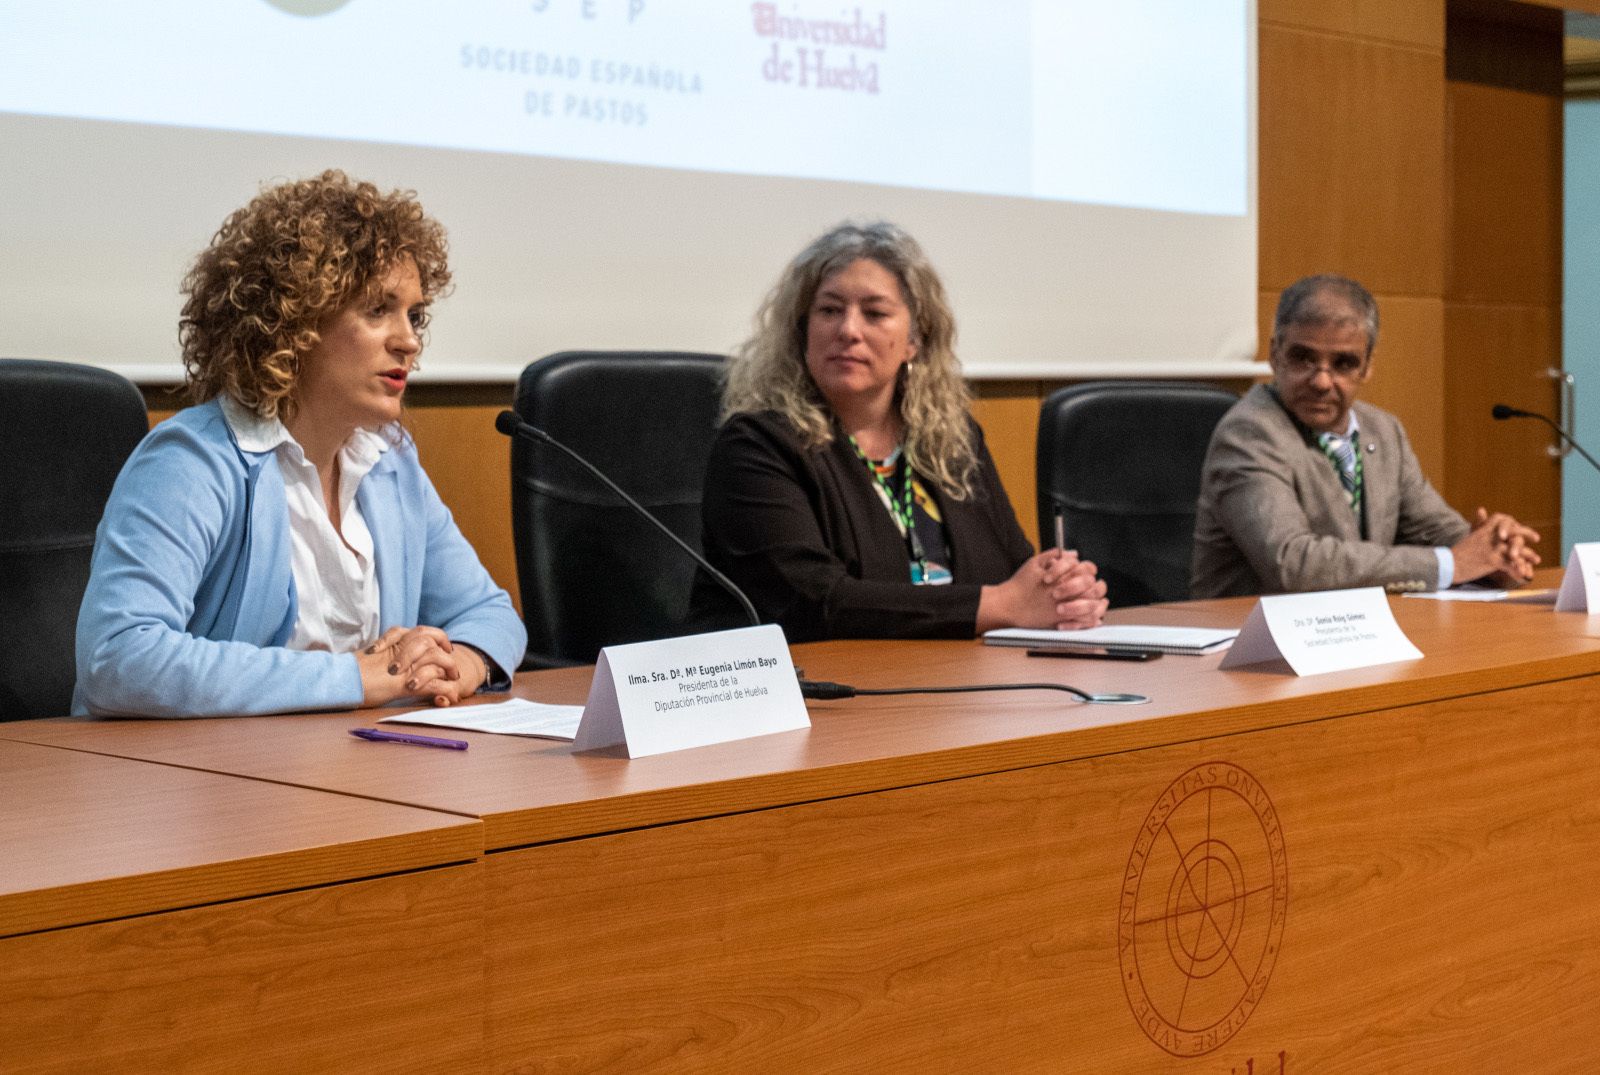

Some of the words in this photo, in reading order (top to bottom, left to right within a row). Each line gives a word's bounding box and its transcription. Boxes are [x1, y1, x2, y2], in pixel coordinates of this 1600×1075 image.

[460, 43, 580, 79] SOCIEDAD
[589, 58, 702, 94] ESPAÑOLA
[762, 41, 794, 83] de
[797, 46, 881, 94] Huelva
[525, 91, 553, 116] DE
[564, 94, 648, 125] PASTOS
[628, 674, 650, 686] Ilma.
[651, 672, 668, 682] Sra.
[670, 669, 684, 679] Dª.
[685, 666, 697, 677] Mª
[699, 662, 732, 676] Eugenia
[733, 659, 757, 671] Limón
[758, 656, 777, 669] Bayo
[679, 679, 718, 693] Presidenta
[719, 677, 730, 687] de
[731, 676, 738, 685] la
[655, 697, 695, 713] Diputación
[696, 690, 732, 705] Provincial
[734, 689, 744, 699] de
[745, 686, 769, 698] Huelva
